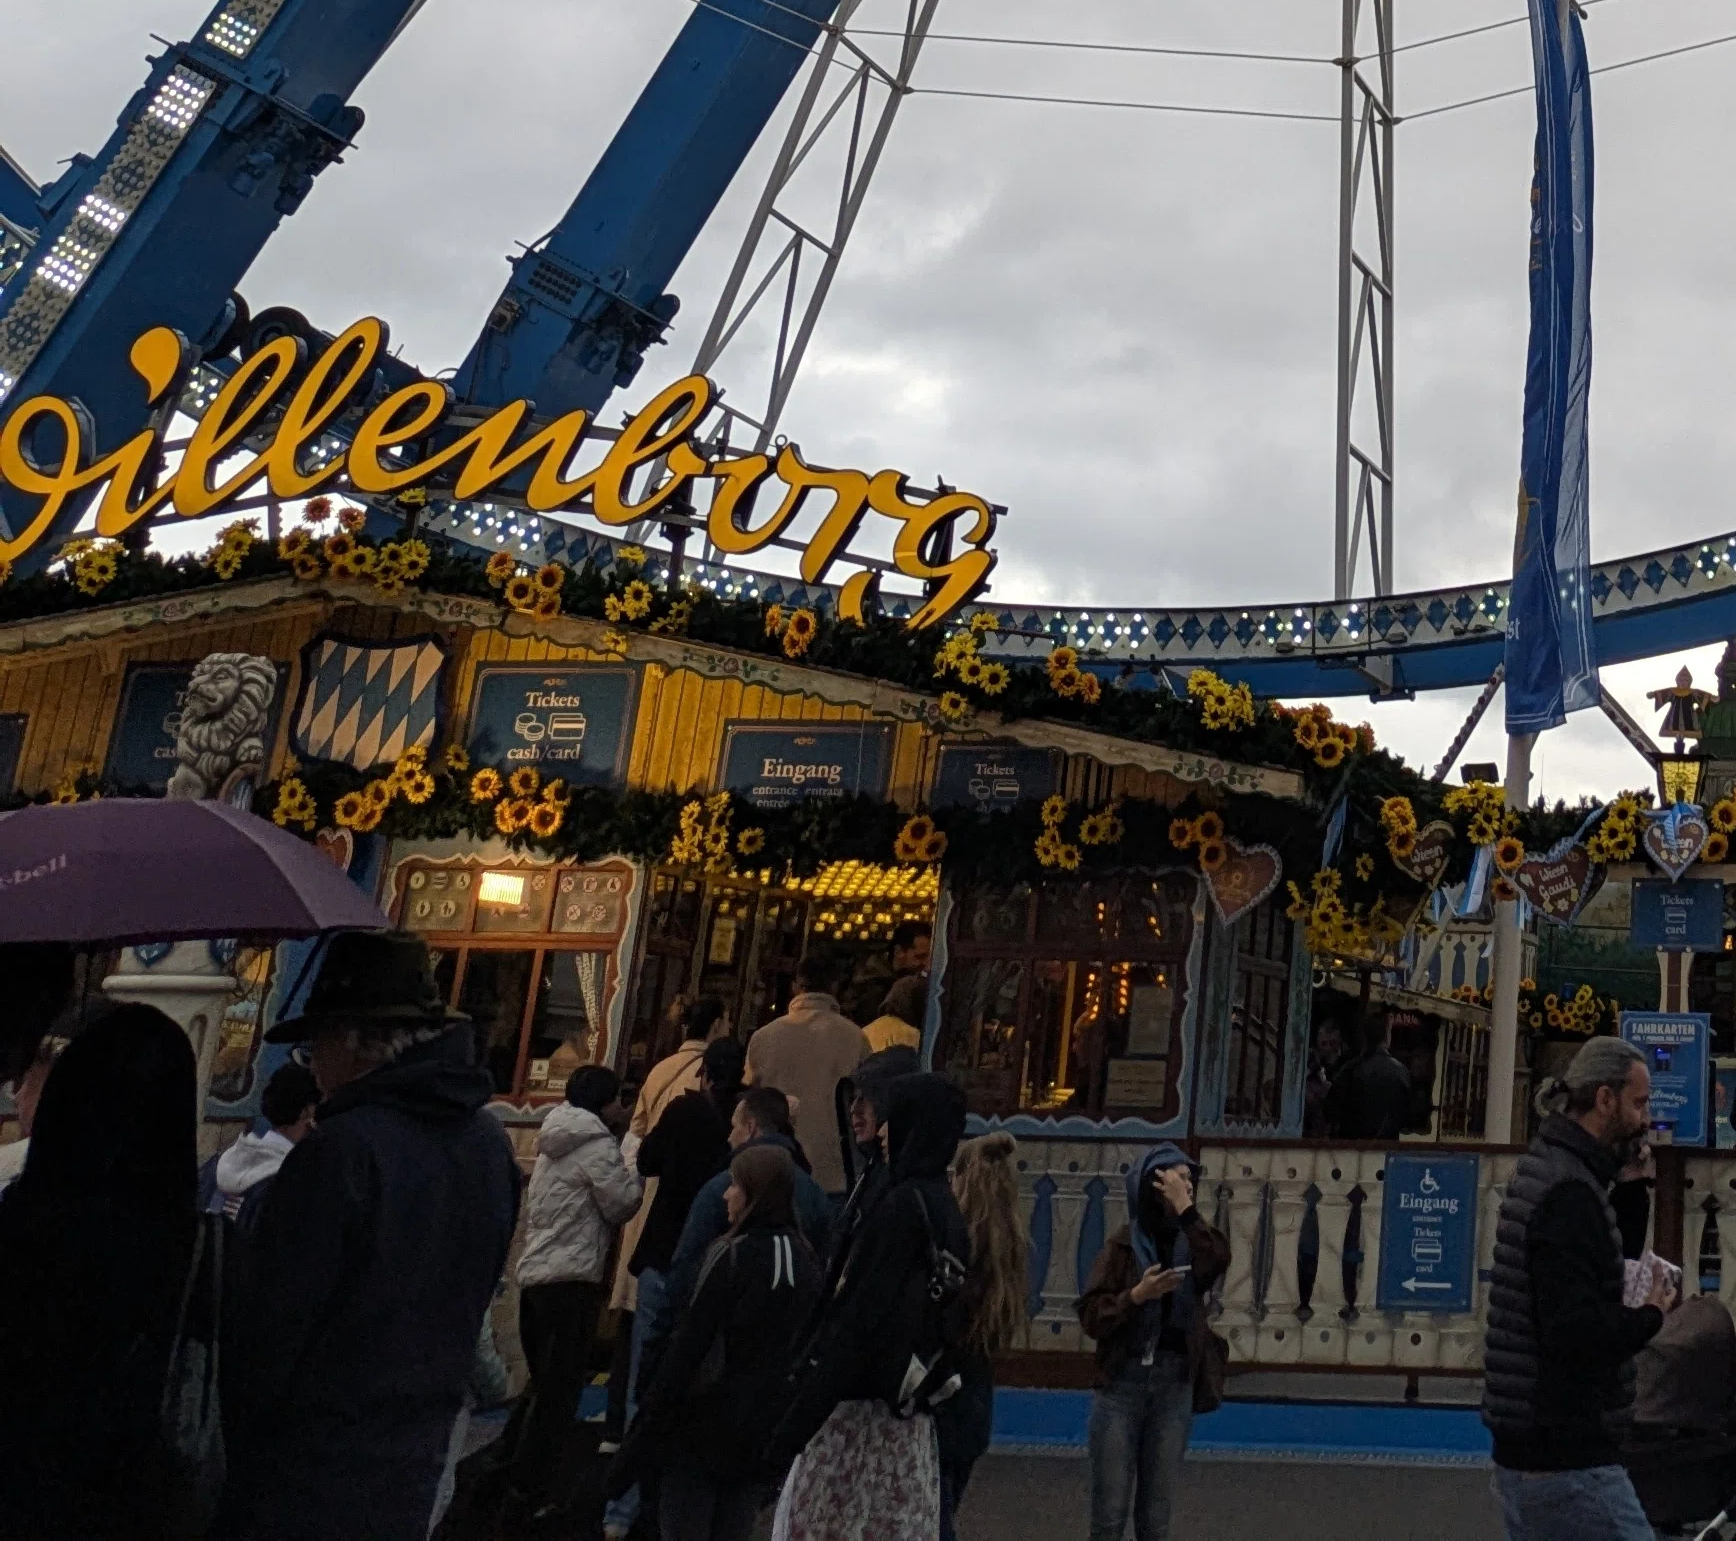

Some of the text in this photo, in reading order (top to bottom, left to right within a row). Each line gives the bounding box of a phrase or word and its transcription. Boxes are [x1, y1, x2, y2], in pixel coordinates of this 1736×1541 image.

[525, 691, 581, 708] Tickets
[506, 743, 582, 762] cash/card
[760, 758, 843, 784] Eingang
[975, 763, 1015, 776] Tickets
[1538, 875, 1577, 900] Gaudi
[1660, 894, 1694, 905] Tickets
[1664, 924, 1687, 935] card
[1632, 1023, 1695, 1035] FAHRKARTEN
[1399, 1192, 1460, 1214] Eingang
